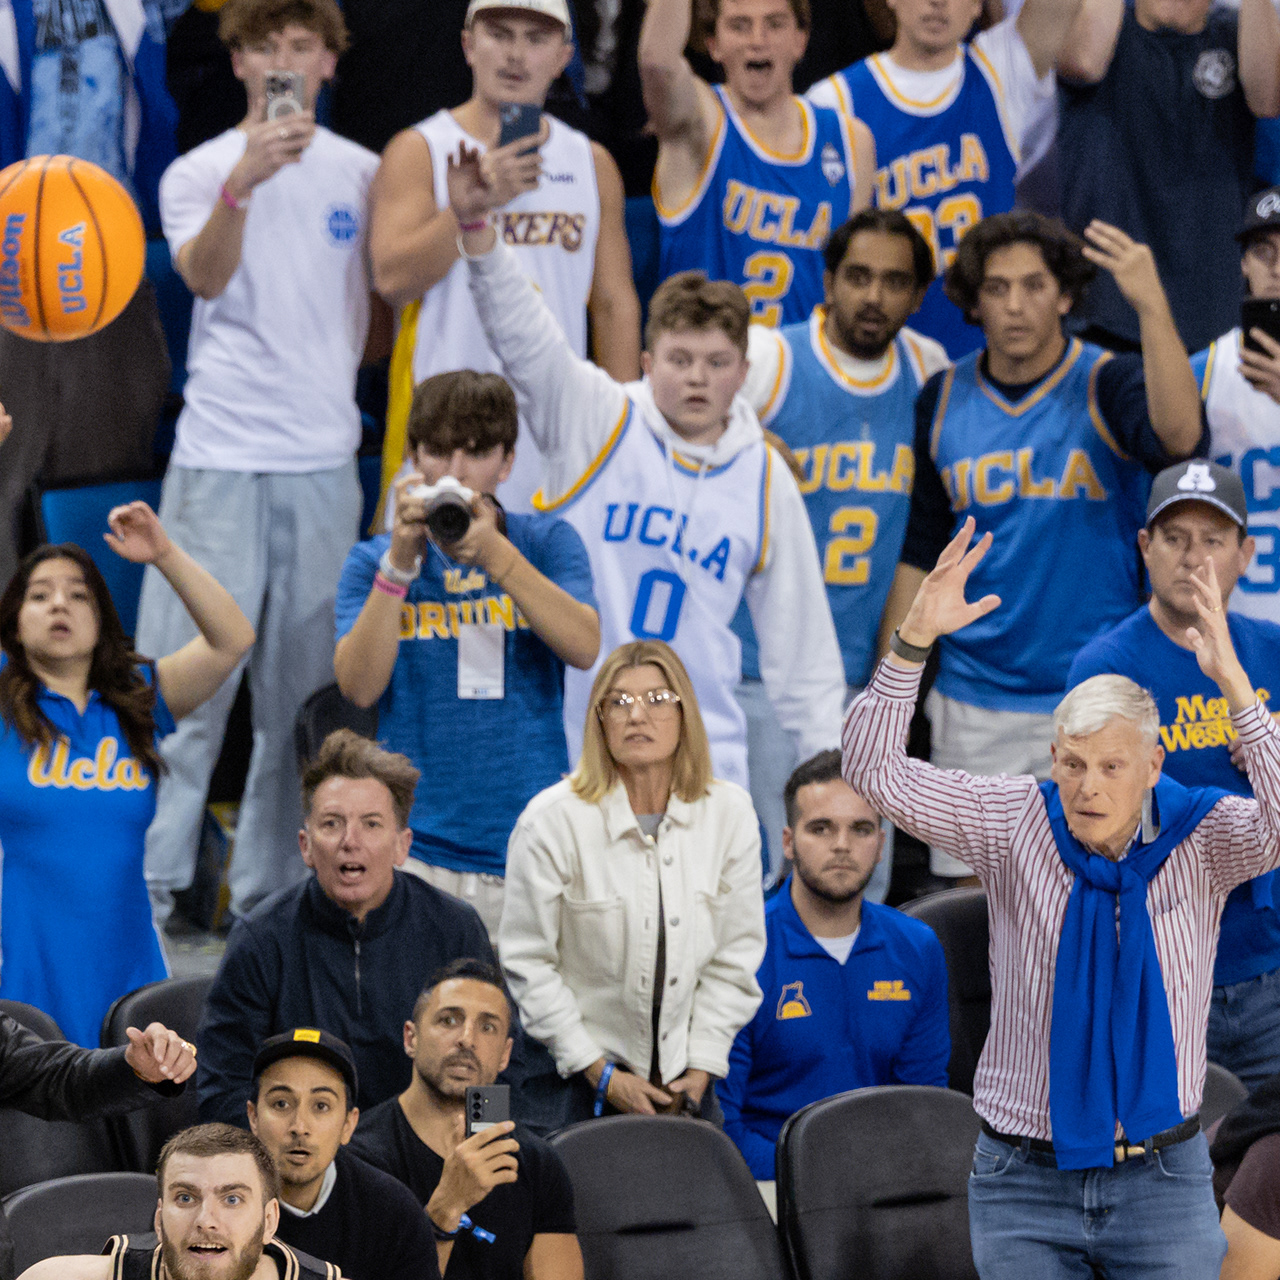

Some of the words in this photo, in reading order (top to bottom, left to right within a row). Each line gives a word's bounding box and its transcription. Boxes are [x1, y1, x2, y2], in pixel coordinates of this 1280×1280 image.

[872, 132, 990, 211] UCLA
[491, 210, 587, 253] KERS
[722, 178, 833, 250] UCLA
[57, 220, 88, 314] UCLA
[742, 251, 794, 330] 2
[790, 440, 915, 496] UCLA
[941, 446, 1108, 513] UCLA
[602, 502, 732, 583] UCLA
[823, 506, 879, 586] 2
[629, 568, 687, 643] 0
[27, 734, 150, 792] Ucla
